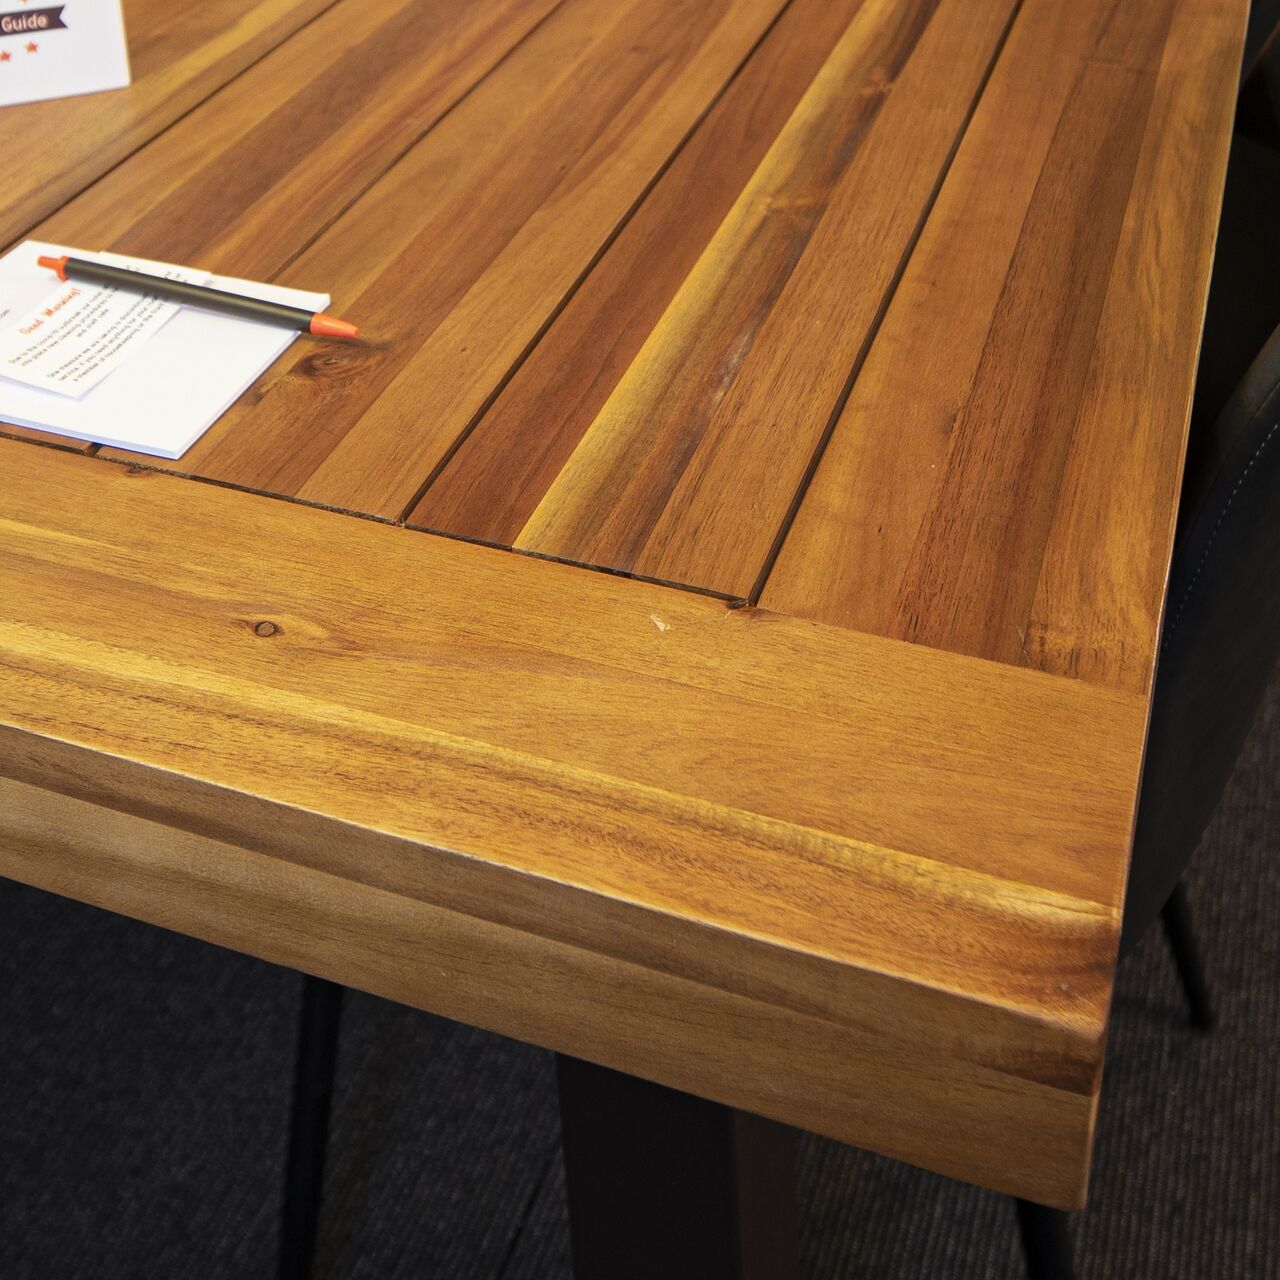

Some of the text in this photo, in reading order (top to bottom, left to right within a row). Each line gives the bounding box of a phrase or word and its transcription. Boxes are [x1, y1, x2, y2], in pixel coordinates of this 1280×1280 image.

[1, 13, 49, 33] Guide
[19, 288, 81, 336] Good Morning!
